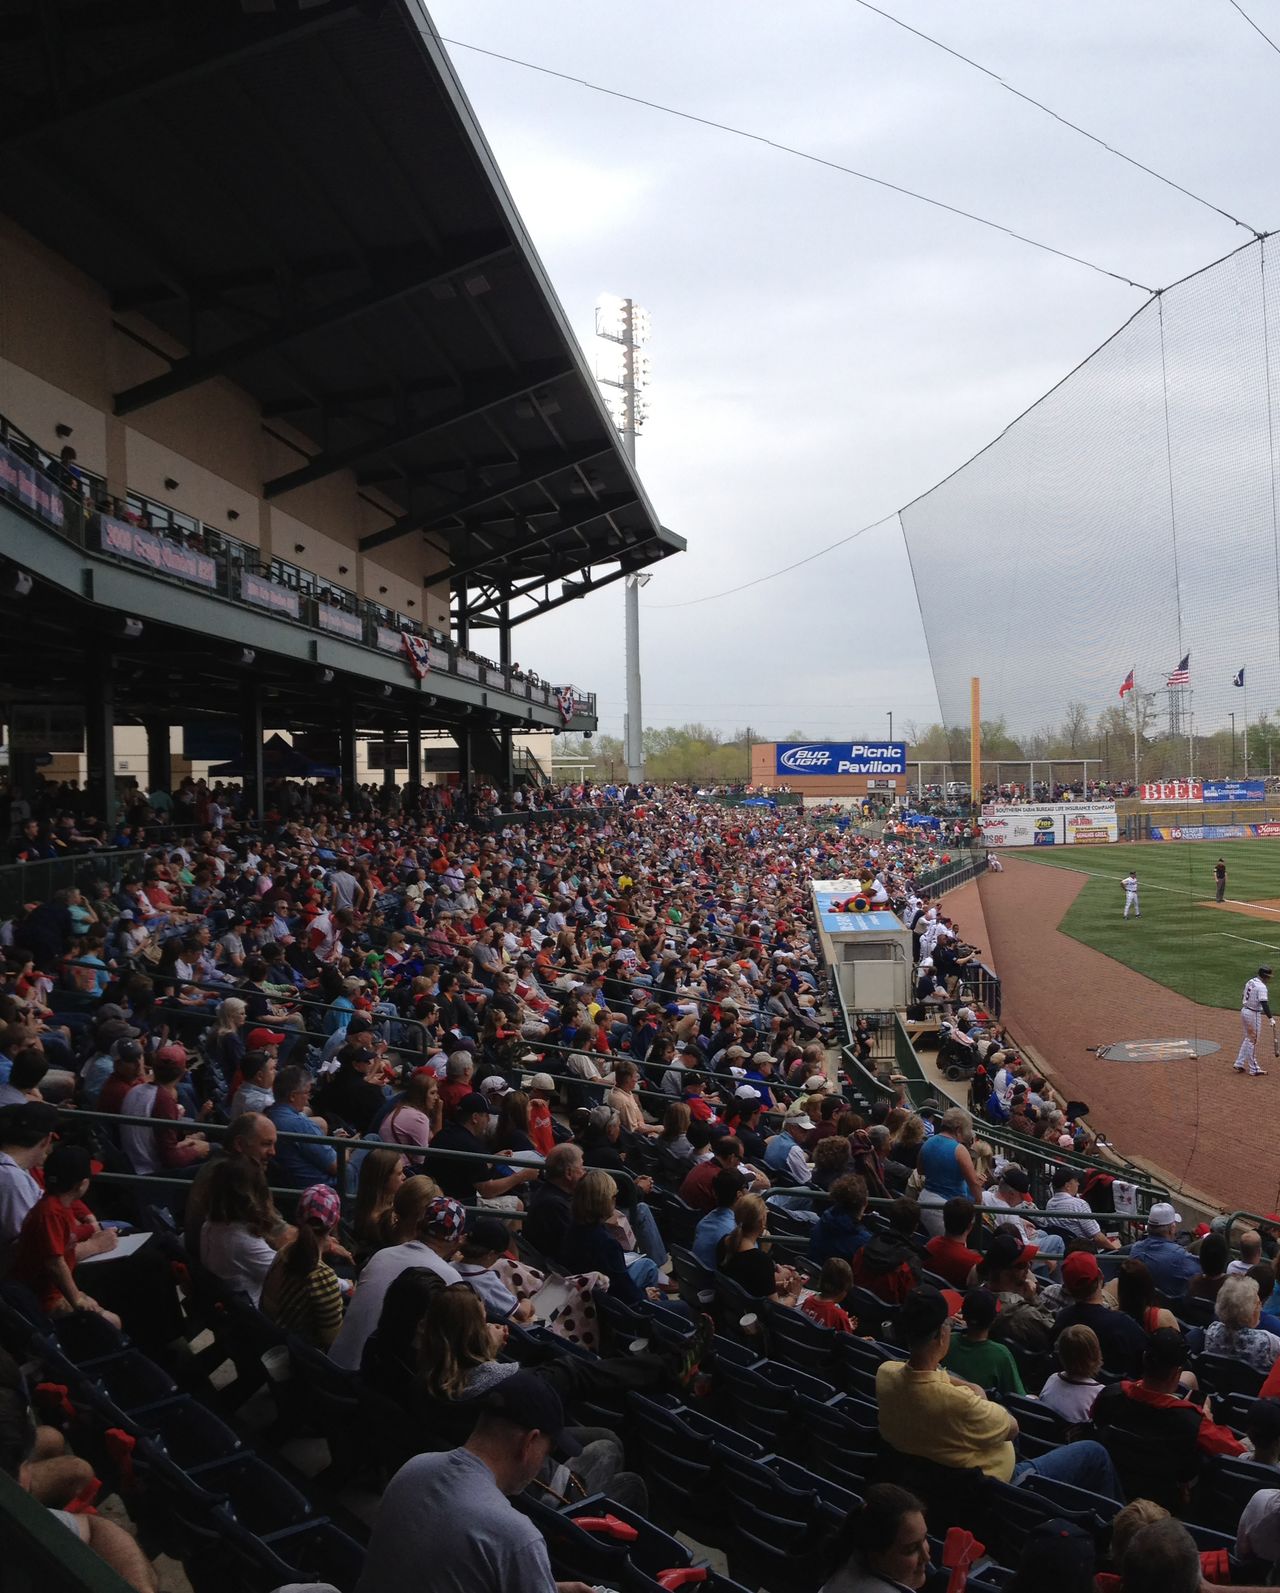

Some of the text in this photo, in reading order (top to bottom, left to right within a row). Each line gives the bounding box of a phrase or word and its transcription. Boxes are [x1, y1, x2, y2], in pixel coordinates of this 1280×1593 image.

[851, 745, 902, 758] Picnic
[838, 761, 902, 773] Pavilion
[1144, 783, 1200, 800] BEEF
